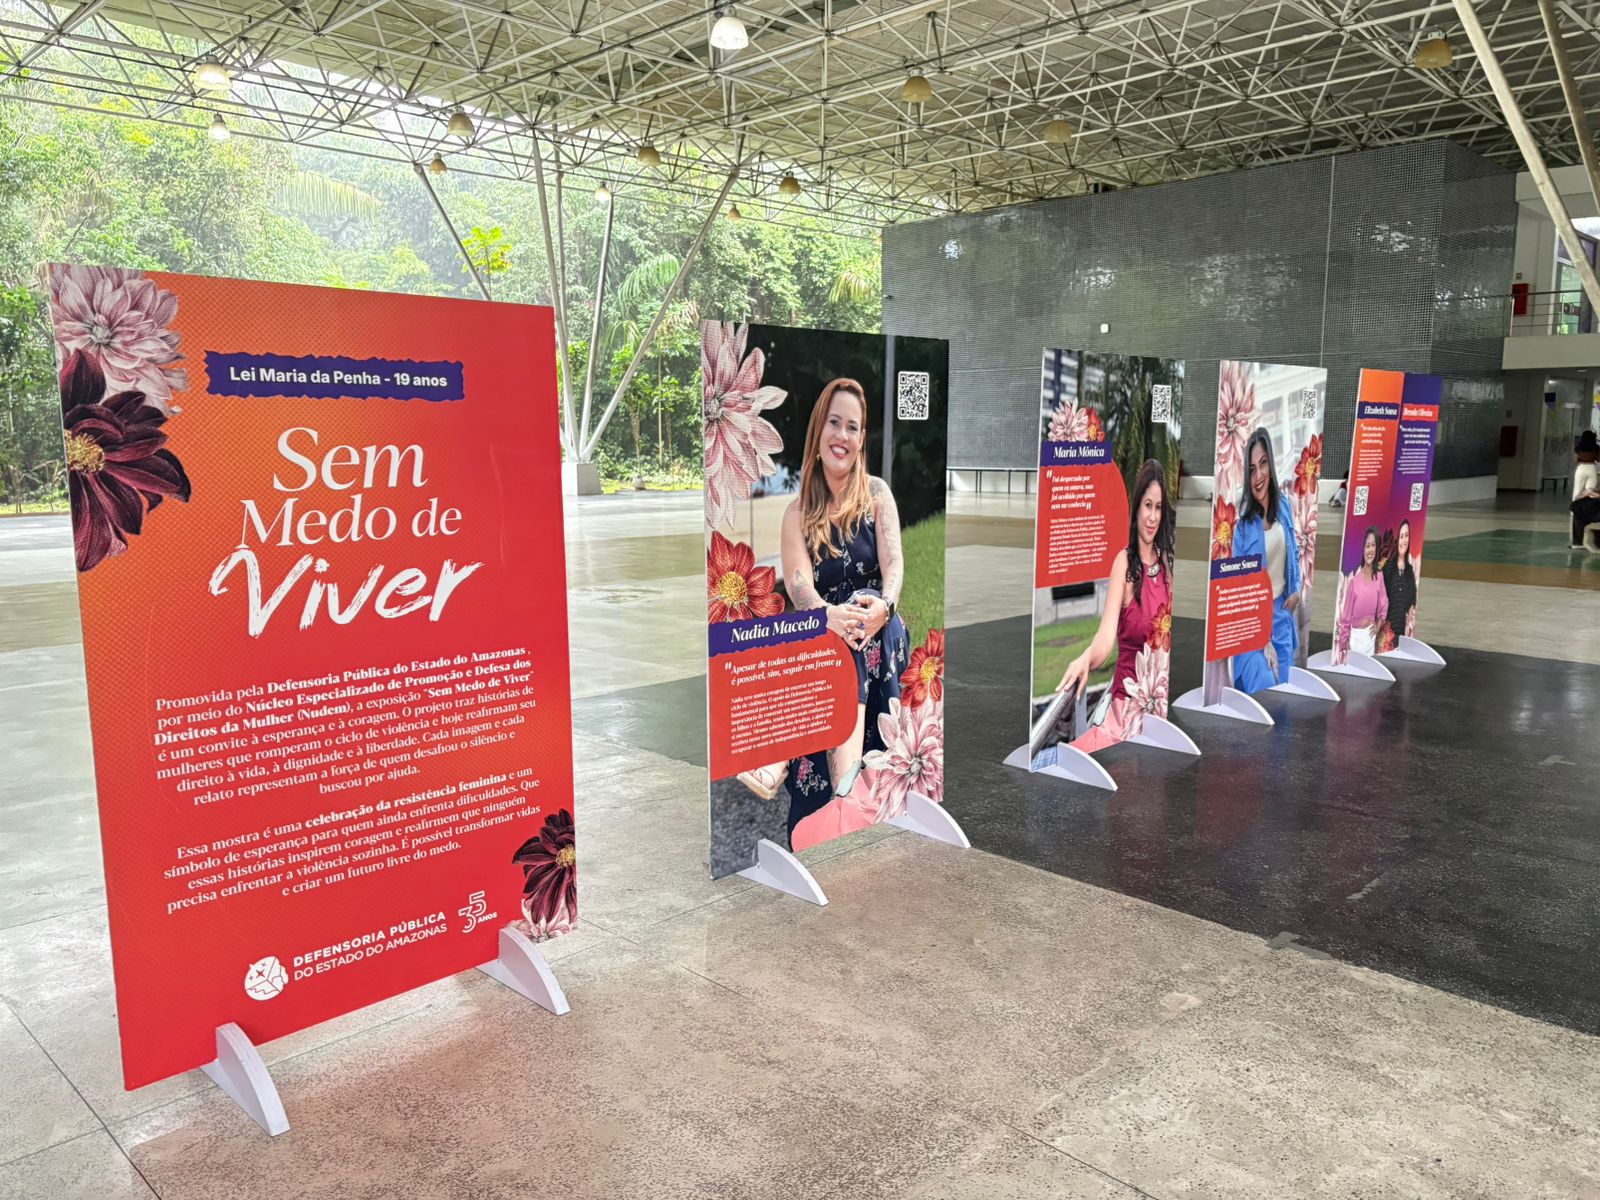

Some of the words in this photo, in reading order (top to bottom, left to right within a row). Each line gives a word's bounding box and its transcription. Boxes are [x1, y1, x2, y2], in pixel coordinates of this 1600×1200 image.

[229, 367, 257, 383] Lei
[260, 368, 307, 384] Maria
[310, 370, 330, 385] da
[333, 370, 380, 386] Penha
[393, 372, 409, 386] 19
[412, 375, 448, 388] anos
[272, 426, 429, 492] Sem
[1053, 446, 1076, 458] Maria
[1078, 446, 1104, 457] Mônica
[235, 494, 396, 548] Medo
[412, 496, 463, 537] de
[208, 549, 485, 638] Viver
[1219, 563, 1241, 573] Simone
[1241, 560, 1258, 569] Sousa
[731, 626, 769, 643] Nadia
[772, 616, 820, 635] Macedo
[768, 658, 786, 667] todas
[797, 648, 837, 663] dificuldades,
[155, 688, 233, 710] Promovida
[236, 684, 264, 701] pela
[266, 672, 340, 693] Defensoria
[342, 666, 390, 681] Pública
[391, 662, 409, 674] do
[410, 656, 451, 671] Estado
[452, 653, 468, 664] do
[469, 646, 526, 662] Amazonas
[157, 715, 183, 730] por
[186, 707, 222, 722] meio
[224, 703, 243, 716] do
[245, 697, 294, 712] Núcleo
[296, 681, 385, 705] Especializado
[386, 678, 402, 689] de
[404, 669, 463, 687] Promoção
[465, 668, 472, 676] e
[474, 662, 510, 675] Defesa
[512, 658, 531, 668] dos
[736, 671, 765, 686] possível,
[767, 669, 781, 678] sim,
[783, 663, 803, 675] seguir
[805, 662, 814, 670] em
[153, 726, 218, 745] Direitos
[220, 720, 240, 733] da
[242, 712, 294, 729] Mulher
[296, 701, 354, 721] (Nudem),
[355, 701, 363, 710] a
[365, 691, 421, 709] exposição
[454, 679, 486, 693] Medo
[487, 676, 501, 687] de
[156, 758, 224, 778] mulheres
[226, 752, 252, 767] que
[254, 739, 321, 760] romperam
[323, 737, 333, 746] o
[334, 730, 363, 744] ciclo
[364, 727, 379, 738] de
[381, 718, 429, 735] violência
[431, 717, 438, 725] e
[440, 711, 463, 725] hoje
[465, 703, 517, 719] reafirmam
[519, 699, 536, 709] seu
[193, 789, 234, 805] relato
[237, 771, 318, 796] representam
[320, 769, 328, 778] a
[330, 762, 360, 776] força
[362, 758, 377, 769] de
[378, 752, 411, 768] quem
[412, 742, 458, 758] desafiou
[459, 740, 468, 749] o
[469, 731, 507, 747] silêncio
[508, 730, 515, 738] e
[318, 777, 362, 794] buscou
[364, 772, 384, 787] por
[386, 764, 420, 780] ajuda.
[163, 856, 221, 878] símbolo
[223, 851, 240, 863] de
[243, 835, 308, 859] esperança
[310, 828, 338, 845] para
[340, 819, 374, 836] quem
[376, 810, 407, 826] ainda
[409, 800, 454, 817] enfrenta
[455, 784, 518, 806] dificuldades.
[519, 778, 540, 791] Que
[176, 843, 208, 859] Essa
[211, 831, 260, 850] mostra
[262, 826, 271, 838] é
[273, 821, 302, 835] uma
[304, 803, 374, 828] celebração
[375, 799, 391, 811] da
[393, 783, 456, 807] resistência
[458, 773, 507, 791] feminina
[508, 771, 515, 779] e
[516, 767, 533, 777] um
[166, 890, 217, 914] precisa
[220, 872, 283, 896] enfrentar
[285, 870, 294, 879] a
[295, 854, 349, 876] violência
[351, 843, 399, 862] sozinha.
[400, 835, 409, 849] É
[411, 826, 453, 849] possível
[454, 812, 514, 834] transformar
[515, 805, 541, 818] vidas
[187, 872, 224, 889] essas
[227, 857, 285, 879] histórias
[287, 842, 342, 864] inspirem
[343, 829, 393, 849] coragem
[394, 827, 402, 836] e
[404, 812, 459, 833] reafirmem
[461, 807, 481, 820] que
[482, 795, 526, 814] ninguém
[281, 886, 290, 896] e
[291, 877, 322, 893] criar
[324, 871, 345, 884] um
[346, 861, 384, 878] futuro
[386, 854, 411, 867] livre
[412, 848, 427, 860] do
[428, 840, 461, 856] medo.
[293, 930, 385, 967] DEFENSORIA
[389, 911, 446, 938] PÚBLICA
[458, 890, 487, 933] 35
[477, 911, 497, 924] ANOS
[294, 966, 313, 981] DO
[316, 950, 364, 975] ESTADO
[366, 944, 384, 958] DO
[386, 922, 447, 950] AMAZONAS
